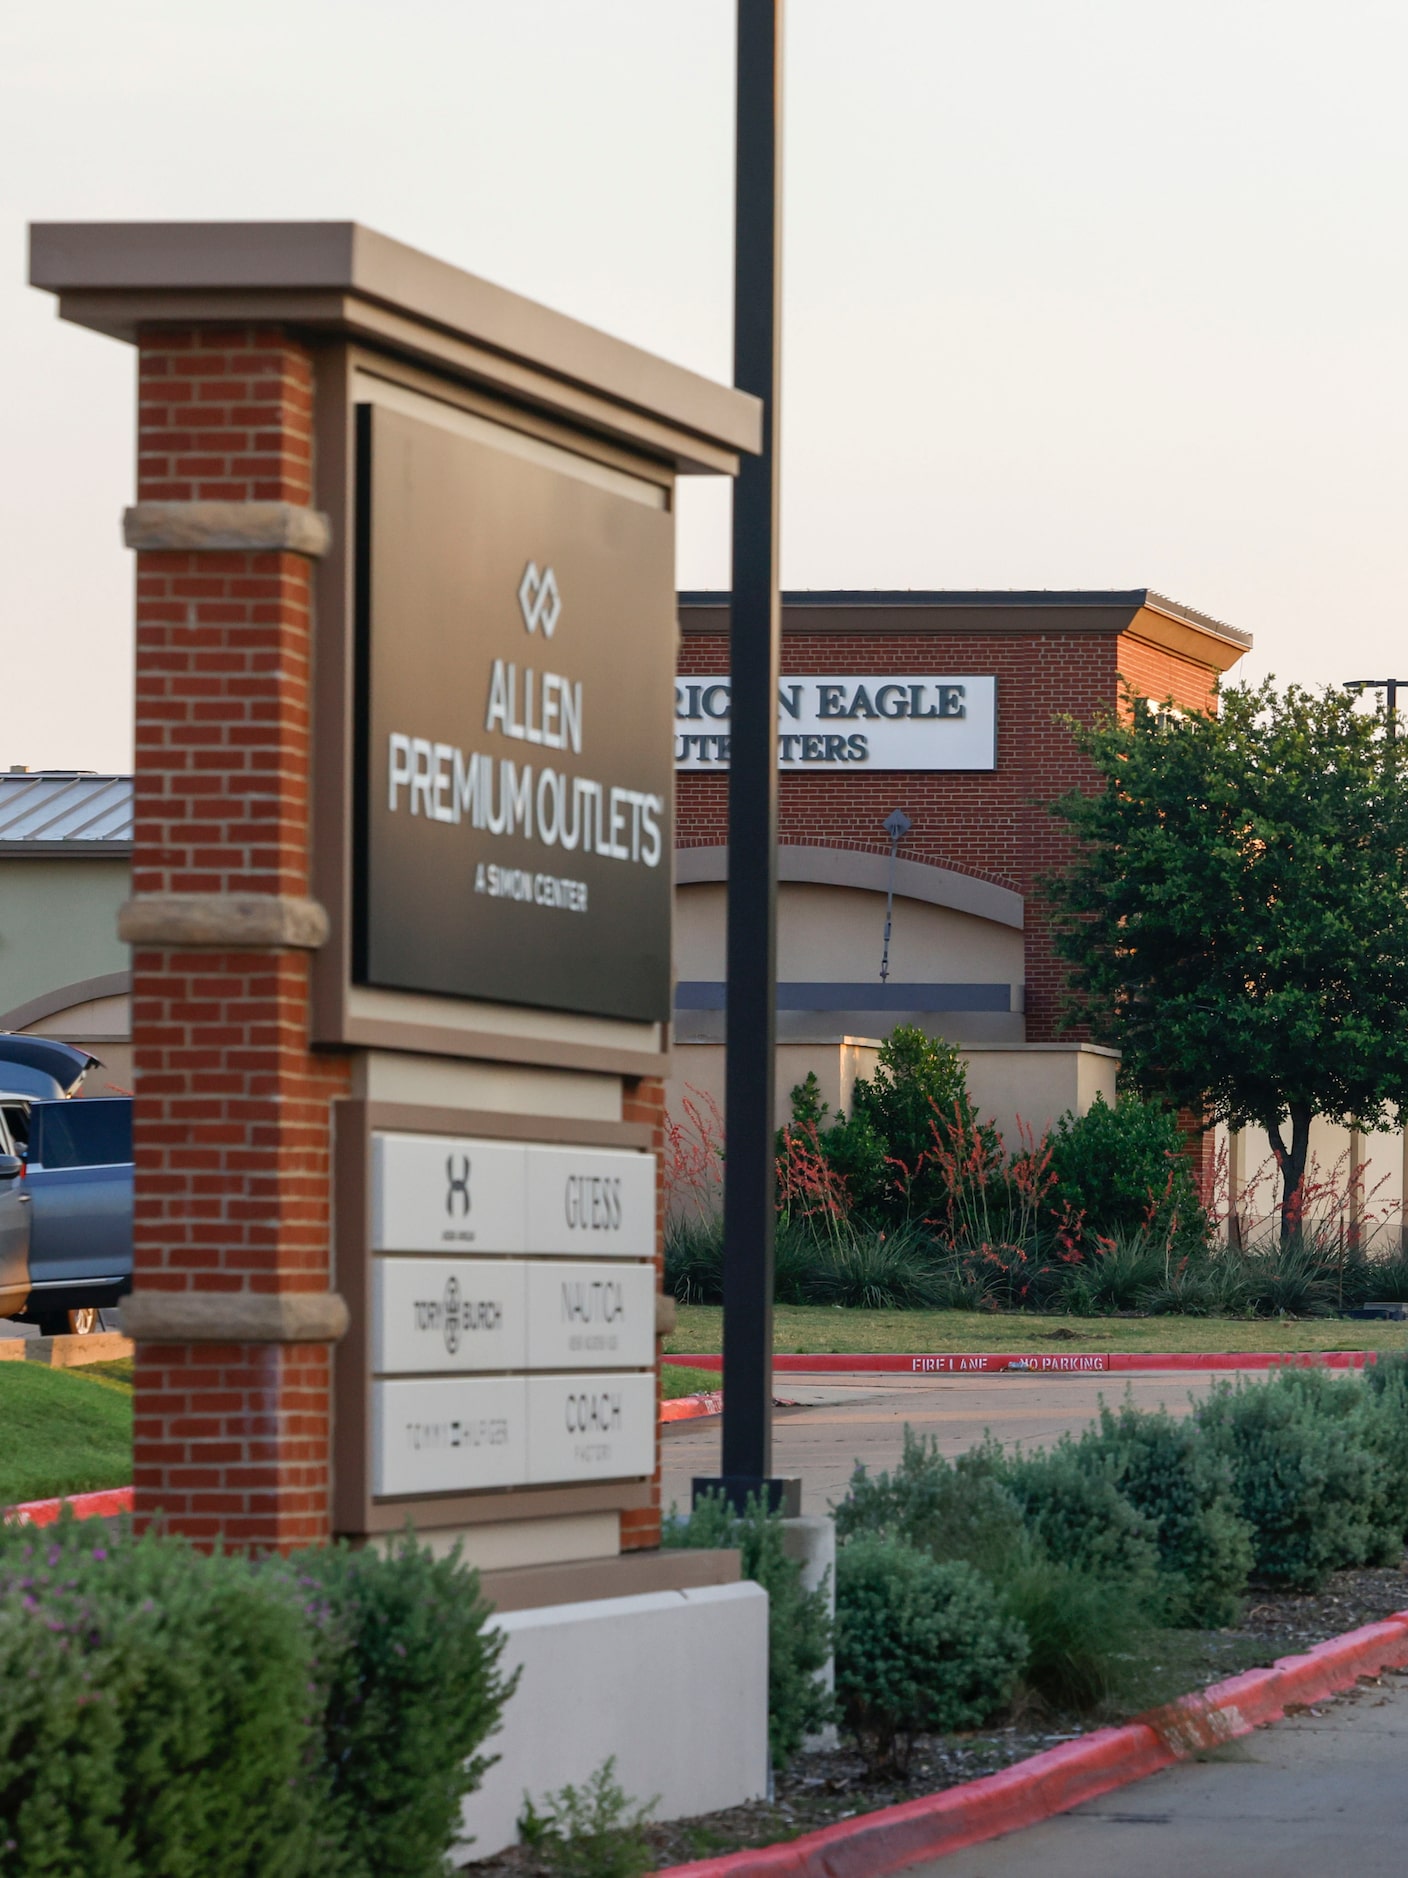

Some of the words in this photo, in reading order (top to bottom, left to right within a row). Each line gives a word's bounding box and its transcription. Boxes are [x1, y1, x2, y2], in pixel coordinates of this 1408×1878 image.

[486, 659, 582, 754] ALLEN
[815, 684, 966, 719] EAGLE
[389, 732, 532, 840] PREMIUM
[536, 767, 662, 868] OUTLETS
[474, 863, 486, 894] A
[487, 863, 533, 902] SIMON
[534, 872, 588, 912] CENTER
[565, 1176, 622, 1230] GUESS
[462, 1301, 503, 1331] BURCH
[561, 1281, 625, 1323] NAUTICA
[1042, 1357, 1103, 1370] PARKING
[565, 1394, 622, 1434] COACH
